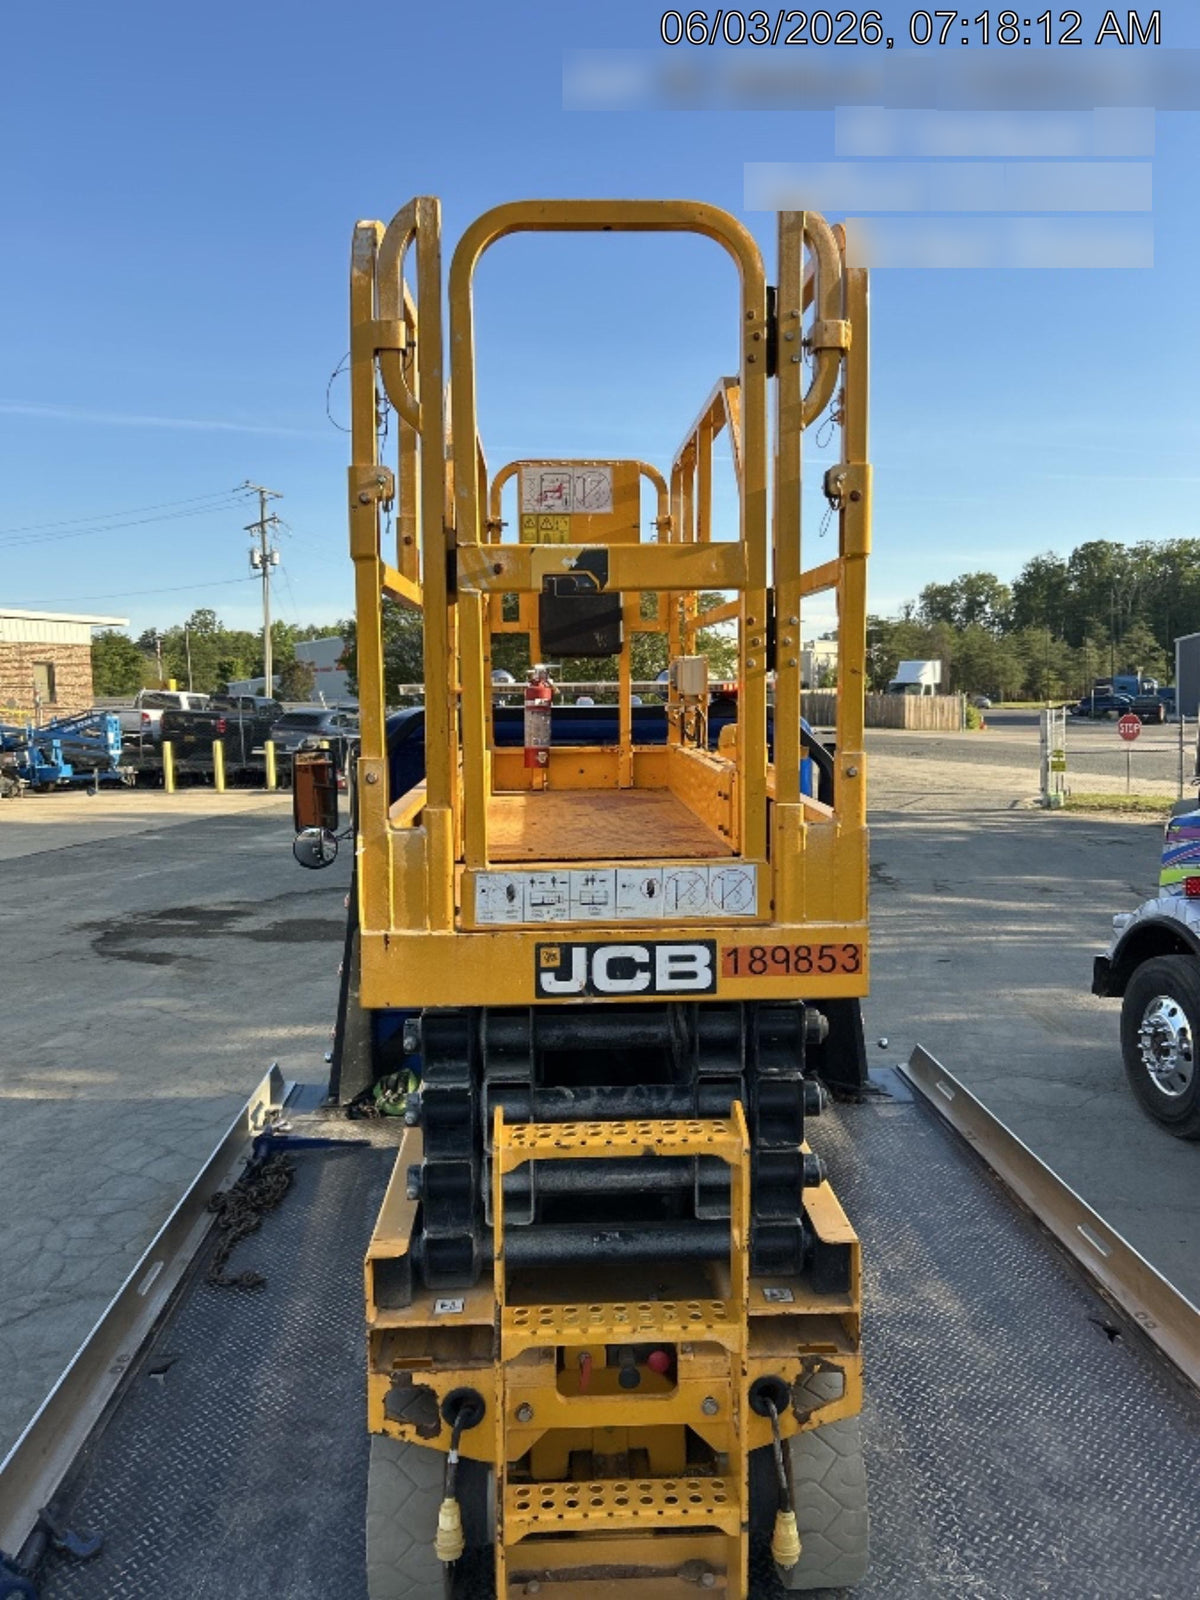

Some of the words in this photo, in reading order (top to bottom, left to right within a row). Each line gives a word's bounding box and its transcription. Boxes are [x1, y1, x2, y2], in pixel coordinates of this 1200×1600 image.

[1119, 723, 1140, 733] STOP
[540, 945, 712, 993] JCB
[726, 943, 861, 975] 189853
